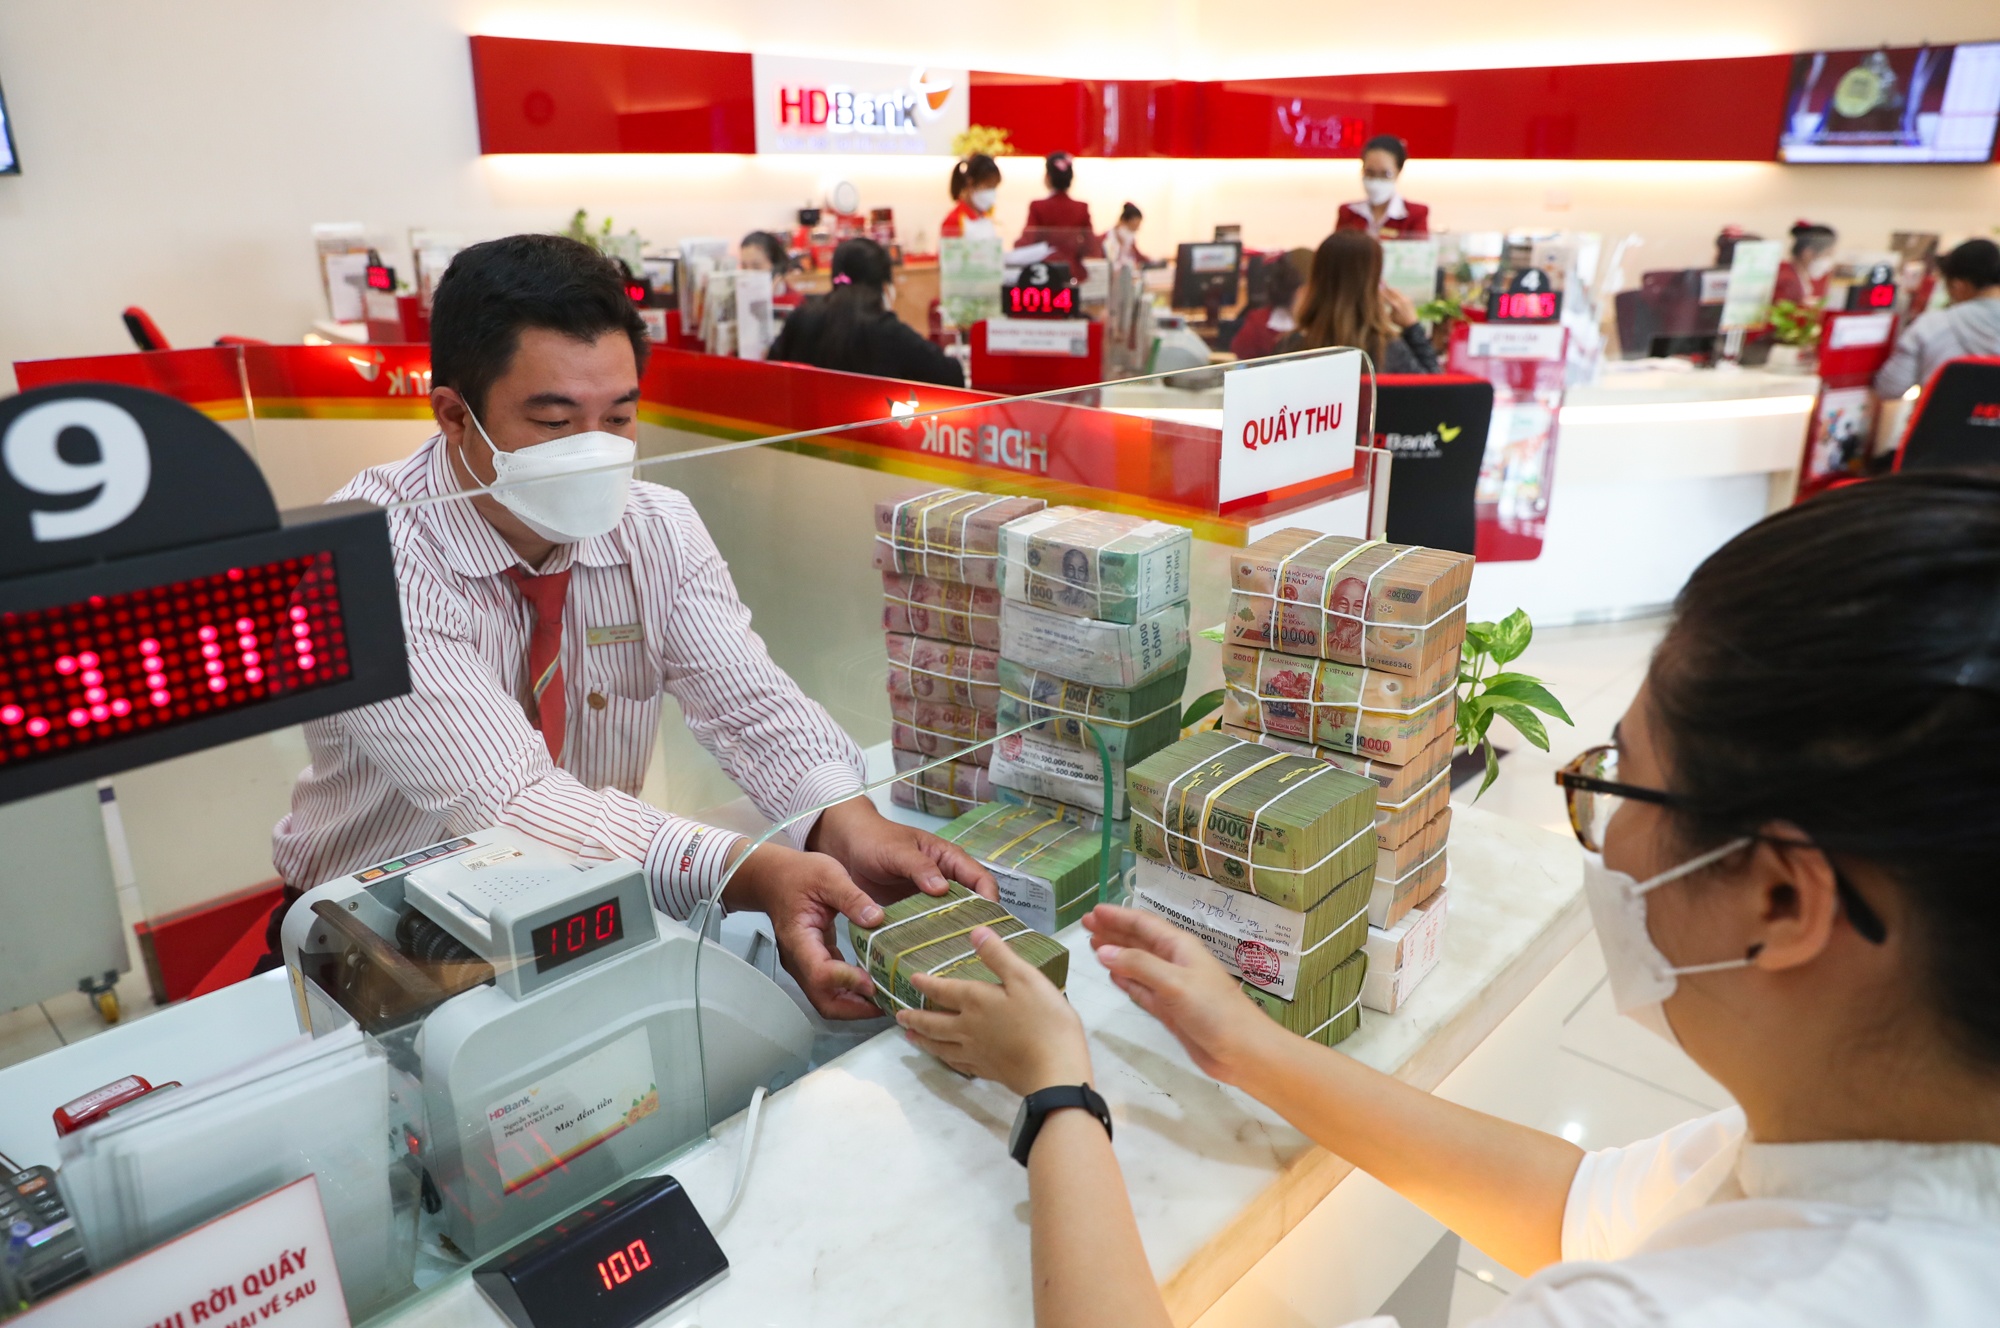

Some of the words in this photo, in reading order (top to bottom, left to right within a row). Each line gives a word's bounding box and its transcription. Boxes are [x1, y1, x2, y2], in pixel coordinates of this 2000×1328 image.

[780, 88, 917, 128] HDBank
[1030, 263, 1049, 285] 3
[1520, 270, 1540, 291] 4
[1010, 287, 1073, 313] 1014
[1242, 405, 1302, 450] QUẦY
[1305, 403, 1342, 434] THU
[3, 397, 151, 542] 9
[1291, 578, 1308, 586] NAM
[1139, 623, 1151, 670] 500.000
[1341, 669, 1354, 677] NAM
[1041, 755, 1067, 767] 500.000
[1067, 762, 1084, 770] ĐỒNG
[1055, 768, 1099, 782] 500.000.000
[679, 831, 703, 873] HDBank
[1153, 900, 1197, 927] 100.000.000
[552, 904, 614, 956] 100
[489, 1096, 530, 1121] HDBank
[524, 1113, 545, 1128] DVKH
[554, 1117, 575, 1134] Máy
[576, 1106, 595, 1122] đếm
[596, 1096, 614, 1110] tiền
[597, 1238, 652, 1291] 100
[190, 1285, 237, 1324] RỜI
[284, 1279, 317, 1307] SAU
